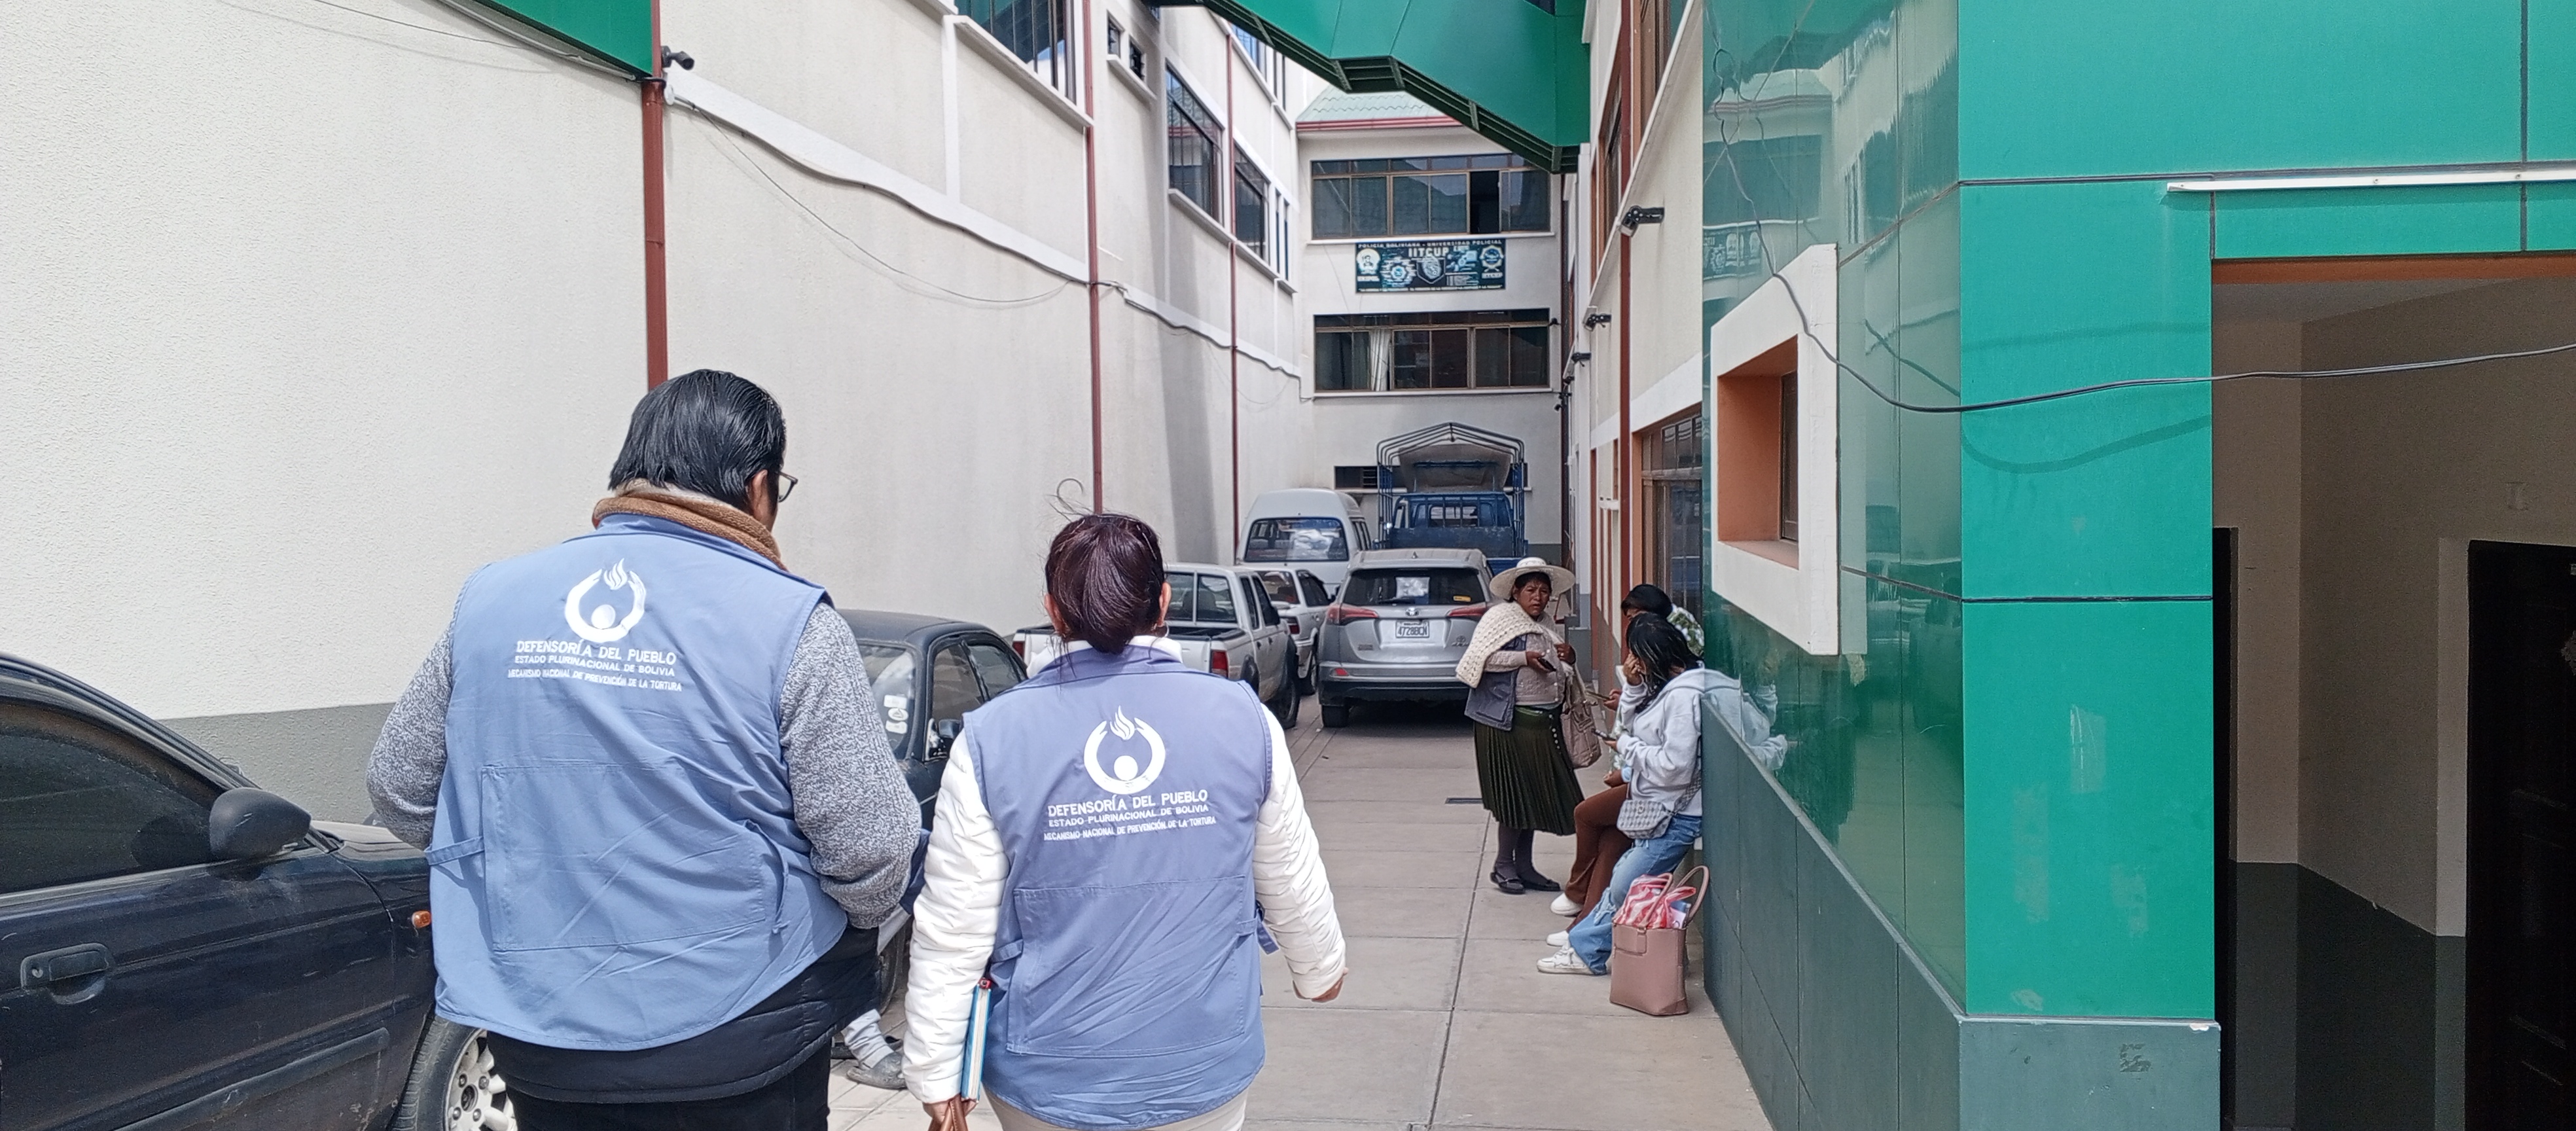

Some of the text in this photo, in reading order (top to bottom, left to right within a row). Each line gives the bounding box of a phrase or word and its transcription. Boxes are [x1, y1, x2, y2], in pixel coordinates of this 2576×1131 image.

[1408, 247, 1449, 257] IITCUP
[516, 639, 677, 666] DEFENSORÍA DEL PUEBLO
[514, 655, 675, 677] ESTADO PLURINACIONAL DE BOLIVIA
[542, 669, 571, 678] NACIONAL
[572, 670, 584, 679] DE
[584, 673, 627, 687] PREVENCIÓN
[628, 678, 637, 687] DE
[638, 679, 649, 689] LA
[650, 680, 682, 692] TORTURA
[1048, 789, 1208, 817] DEFENSORÍA DEL PUEBLO
[1048, 804, 1209, 827] ESTADO PLURINACIONAL DE BOLIVIA
[1043, 816, 1217, 841] MECANISMO NACIONAL DE PREVENCIÓN DE LA TORTURA
